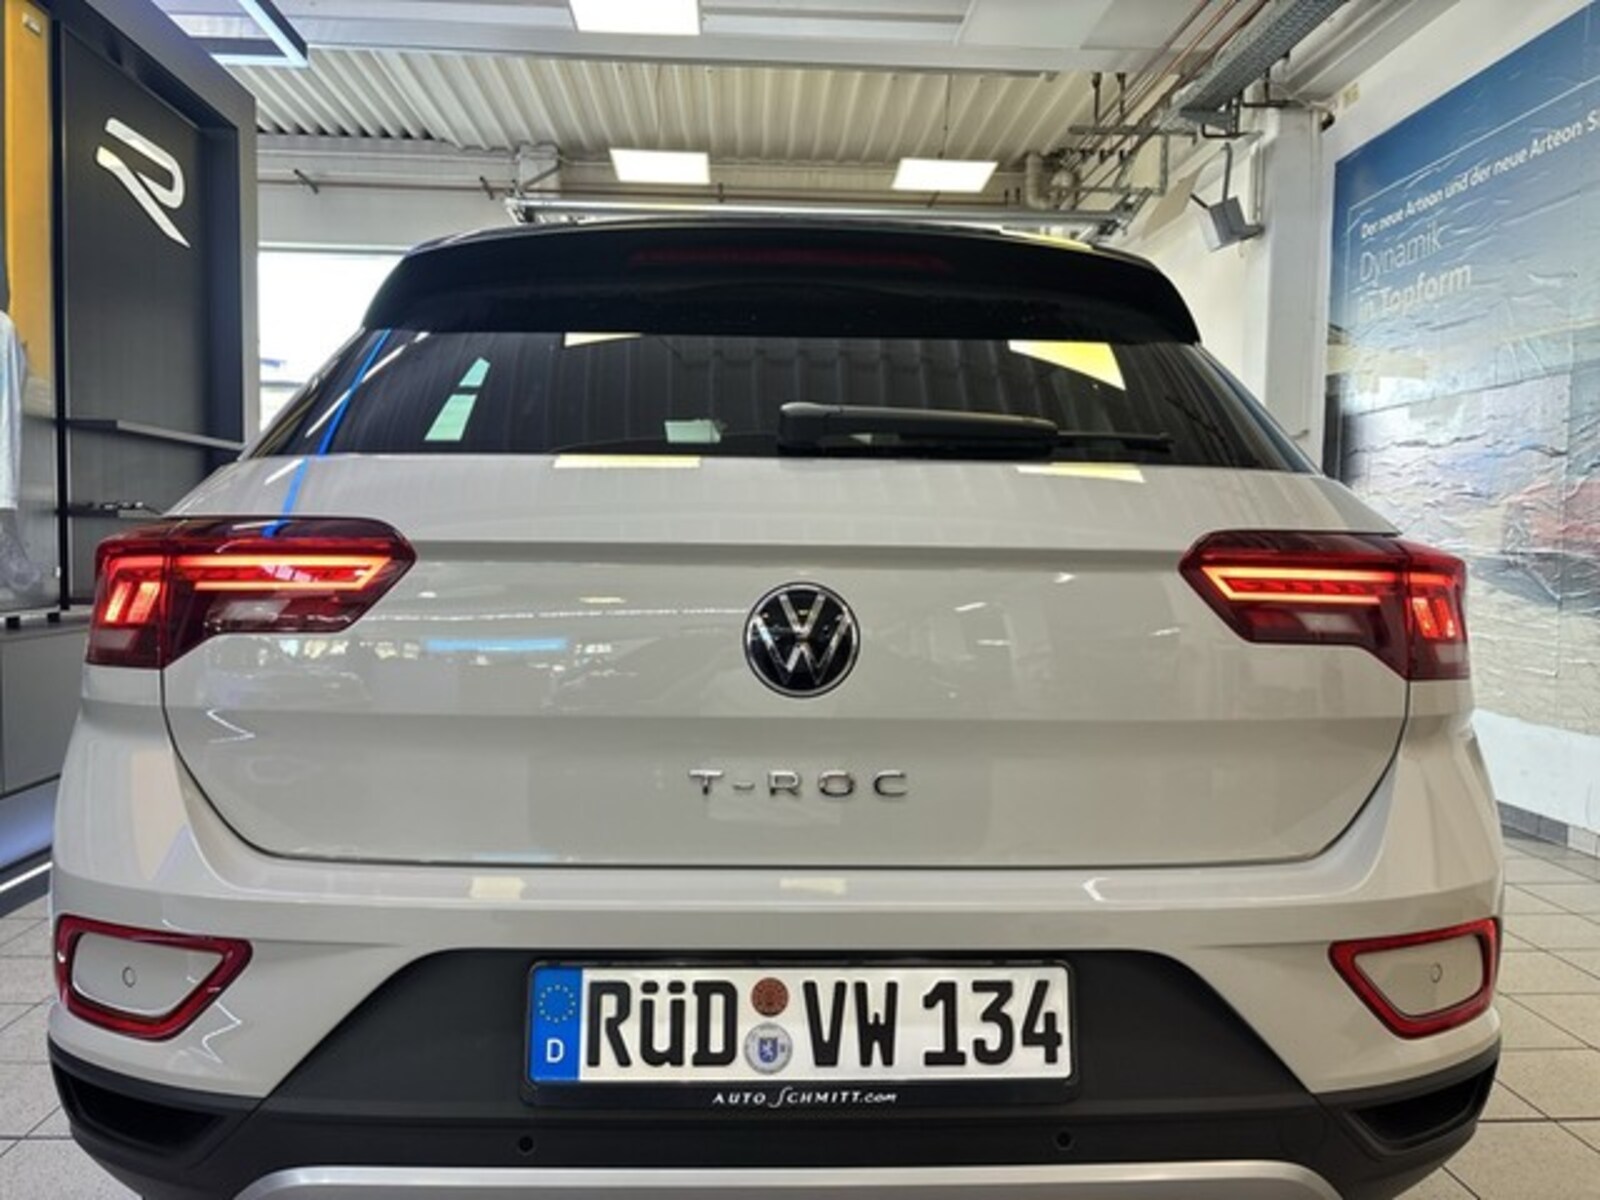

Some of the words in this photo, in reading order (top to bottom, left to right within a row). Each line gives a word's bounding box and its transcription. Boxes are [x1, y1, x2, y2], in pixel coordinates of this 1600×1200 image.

[1404, 187, 1443, 218] Arteon
[1444, 171, 1468, 198] und
[1469, 163, 1491, 187] der
[1492, 147, 1528, 176] neue
[1529, 120, 1582, 159] Arteon
[1360, 220, 1448, 288] Dynamik
[1369, 264, 1471, 317] Topform
[688, 769, 908, 799] T-ROC
[803, 980, 898, 1067] VW
[922, 979, 1063, 1066] 134
[546, 1039, 564, 1063] D
[712, 1091, 767, 1105] AUTO
